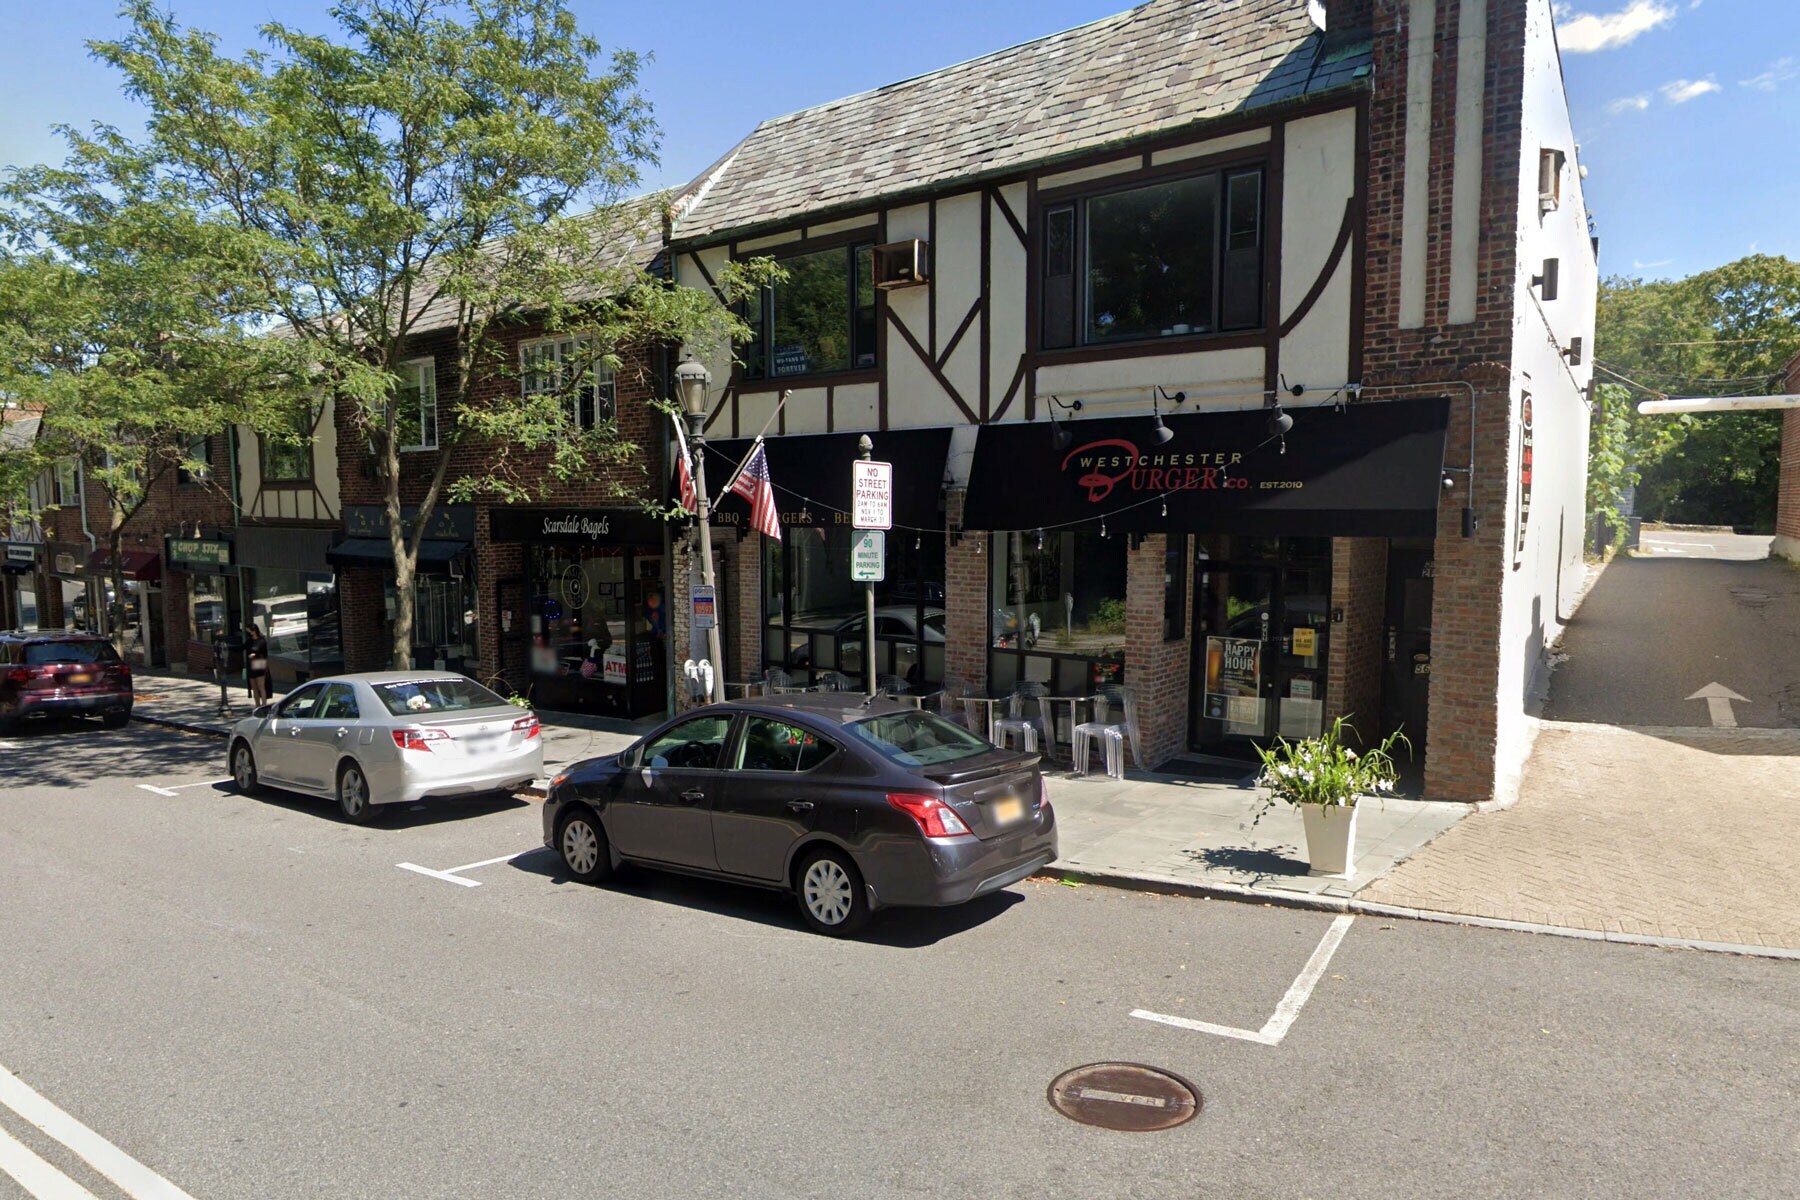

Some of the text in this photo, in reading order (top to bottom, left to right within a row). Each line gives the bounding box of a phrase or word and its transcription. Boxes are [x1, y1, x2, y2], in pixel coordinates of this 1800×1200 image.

[1080, 452, 1242, 468] WESTCHESTER
[867, 467, 878, 478] NO
[858, 478, 887, 489] STREET
[1260, 480, 1303, 490] EST.2010
[856, 489, 889, 500] PARKING
[717, 512, 740, 524] BBQ
[542, 515, 609, 540] Scarsdale Bagels
[177, 542, 199, 553] CHOP
[863, 538, 873, 548] 90
[857, 551, 879, 559] MINUTE
[855, 561, 880, 569] PARKING
[1225, 642, 1257, 657] HAPPY
[605, 660, 629, 673] ATM
[1224, 656, 1255, 671] HOUR
